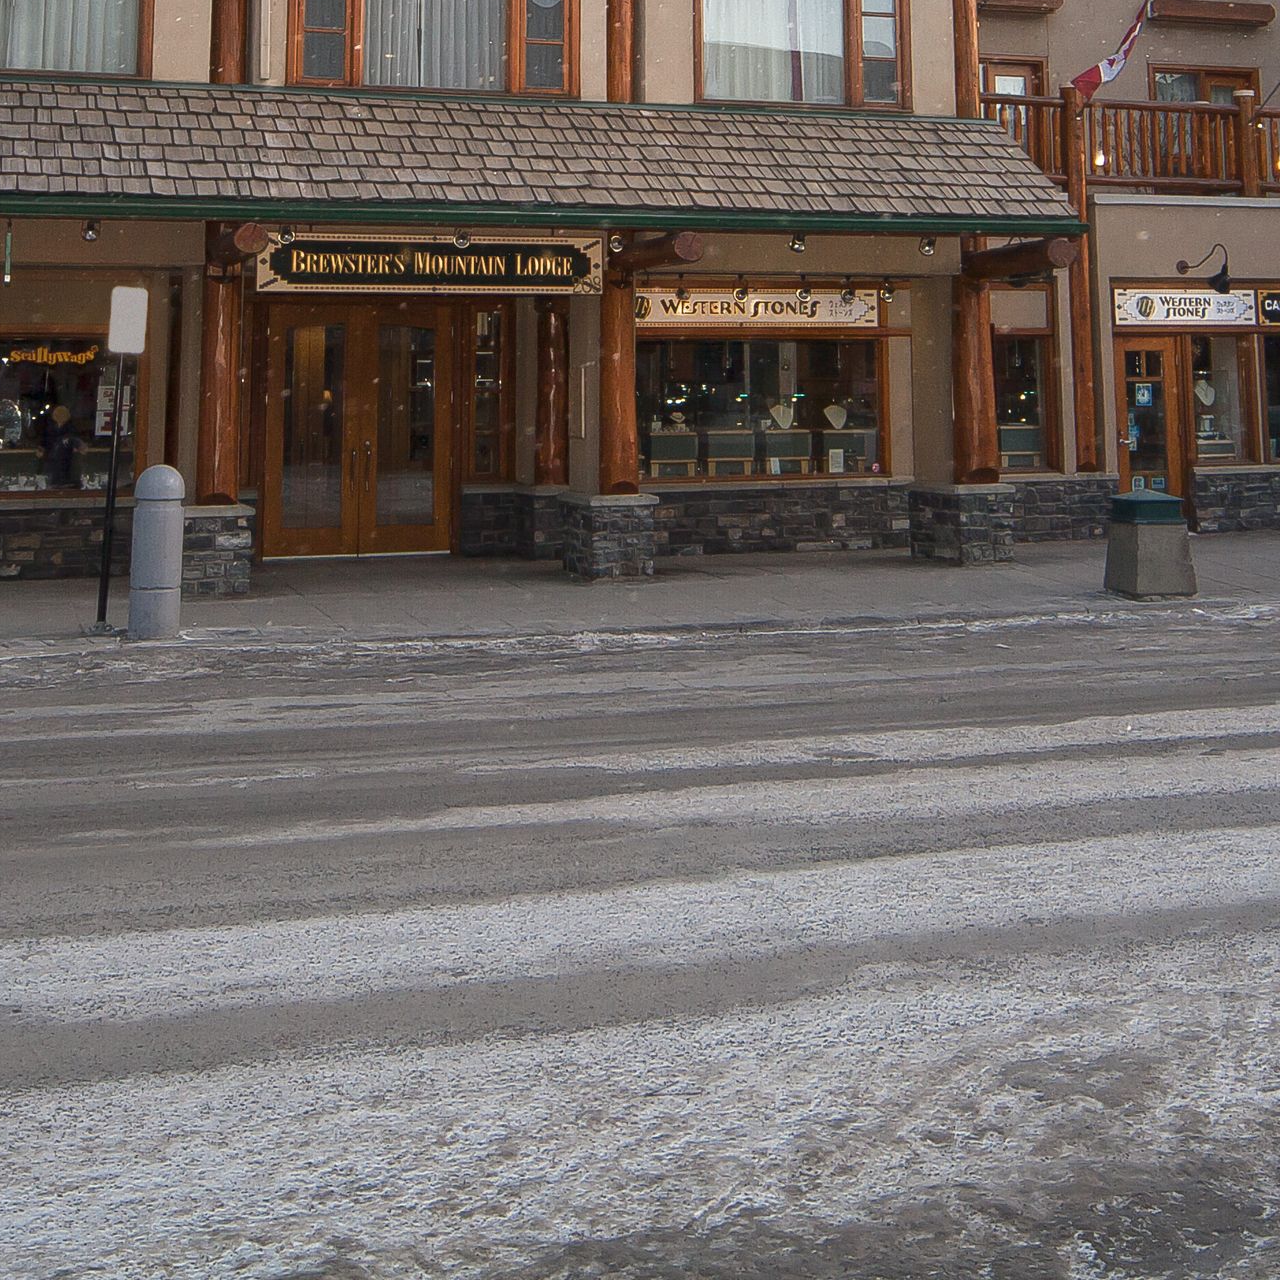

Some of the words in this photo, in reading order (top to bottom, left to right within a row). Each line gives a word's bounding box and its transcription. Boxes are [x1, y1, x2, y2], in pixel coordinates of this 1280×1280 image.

[291, 249, 405, 274] BREWSTER'S
[414, 251, 506, 275] MOUNTAIN
[515, 252, 572, 276] LODGE
[660, 298, 746, 315] WESTERN
[750, 300, 821, 318] STONES
[1159, 296, 1211, 307] WESTERN
[1165, 307, 1208, 318] STONES
